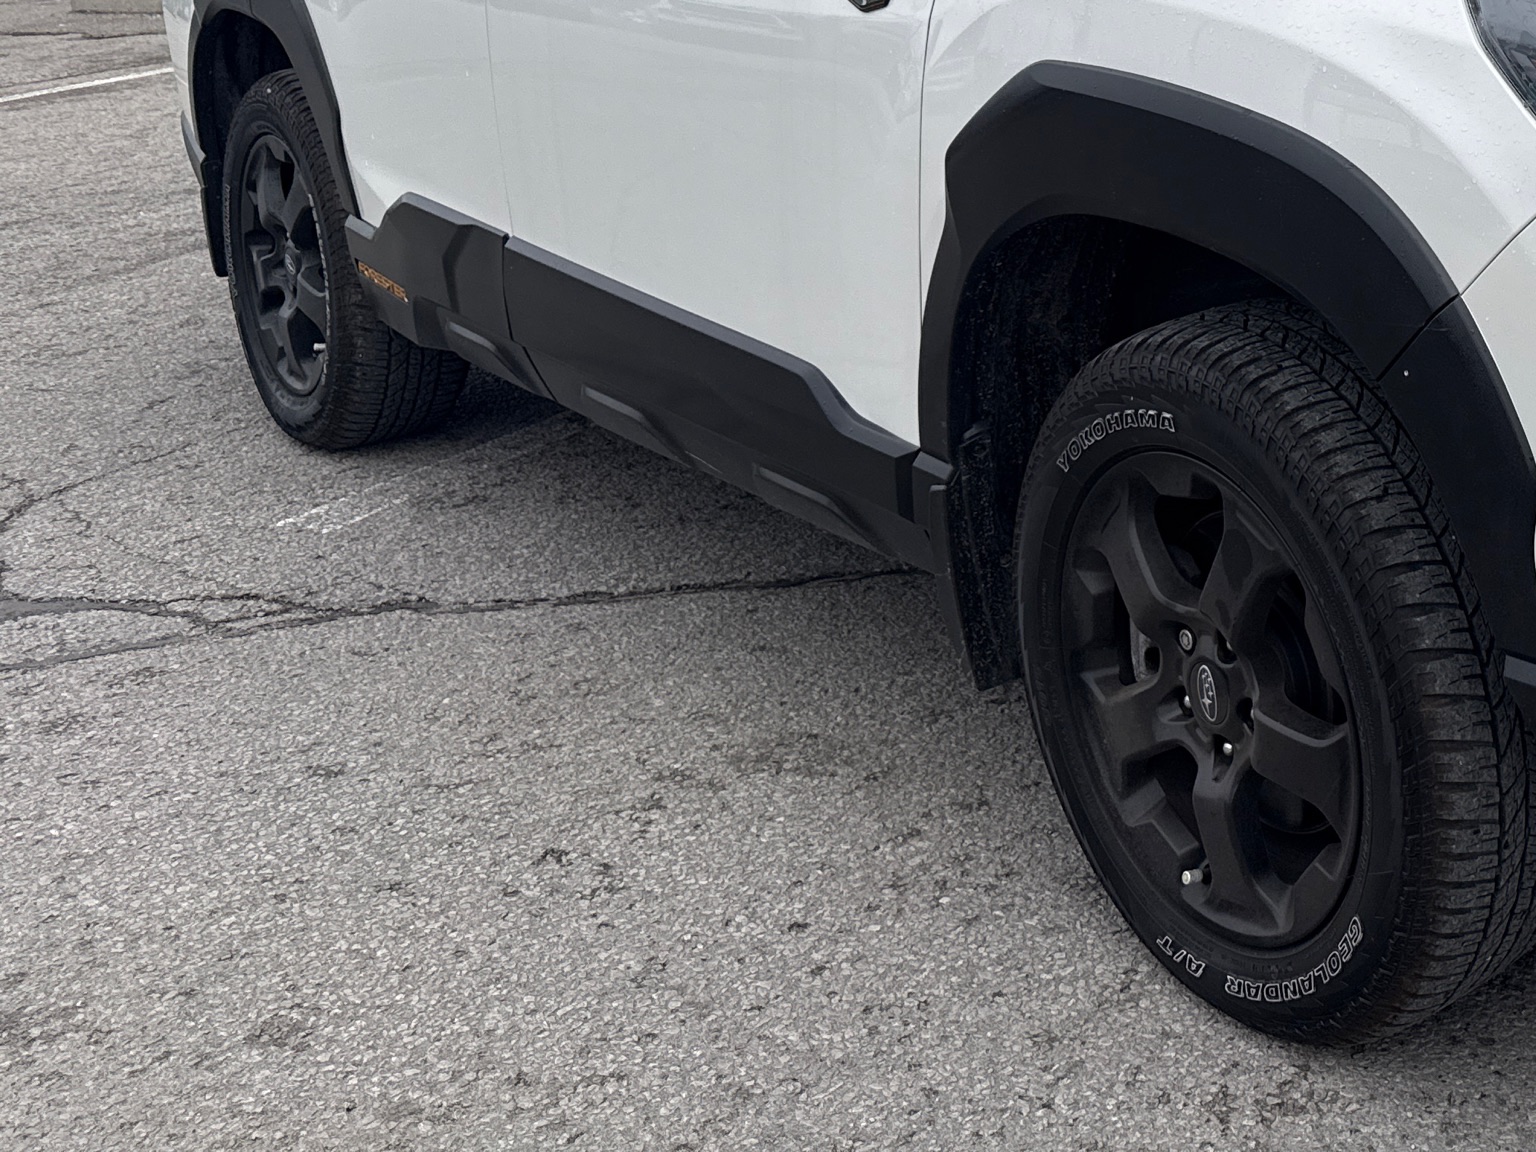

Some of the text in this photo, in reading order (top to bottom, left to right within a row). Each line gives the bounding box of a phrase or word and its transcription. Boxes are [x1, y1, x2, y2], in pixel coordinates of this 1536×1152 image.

[1056, 409, 1176, 473] YOKOHAMA
[1156, 916, 1364, 1002] GEOLANDAR A/T
